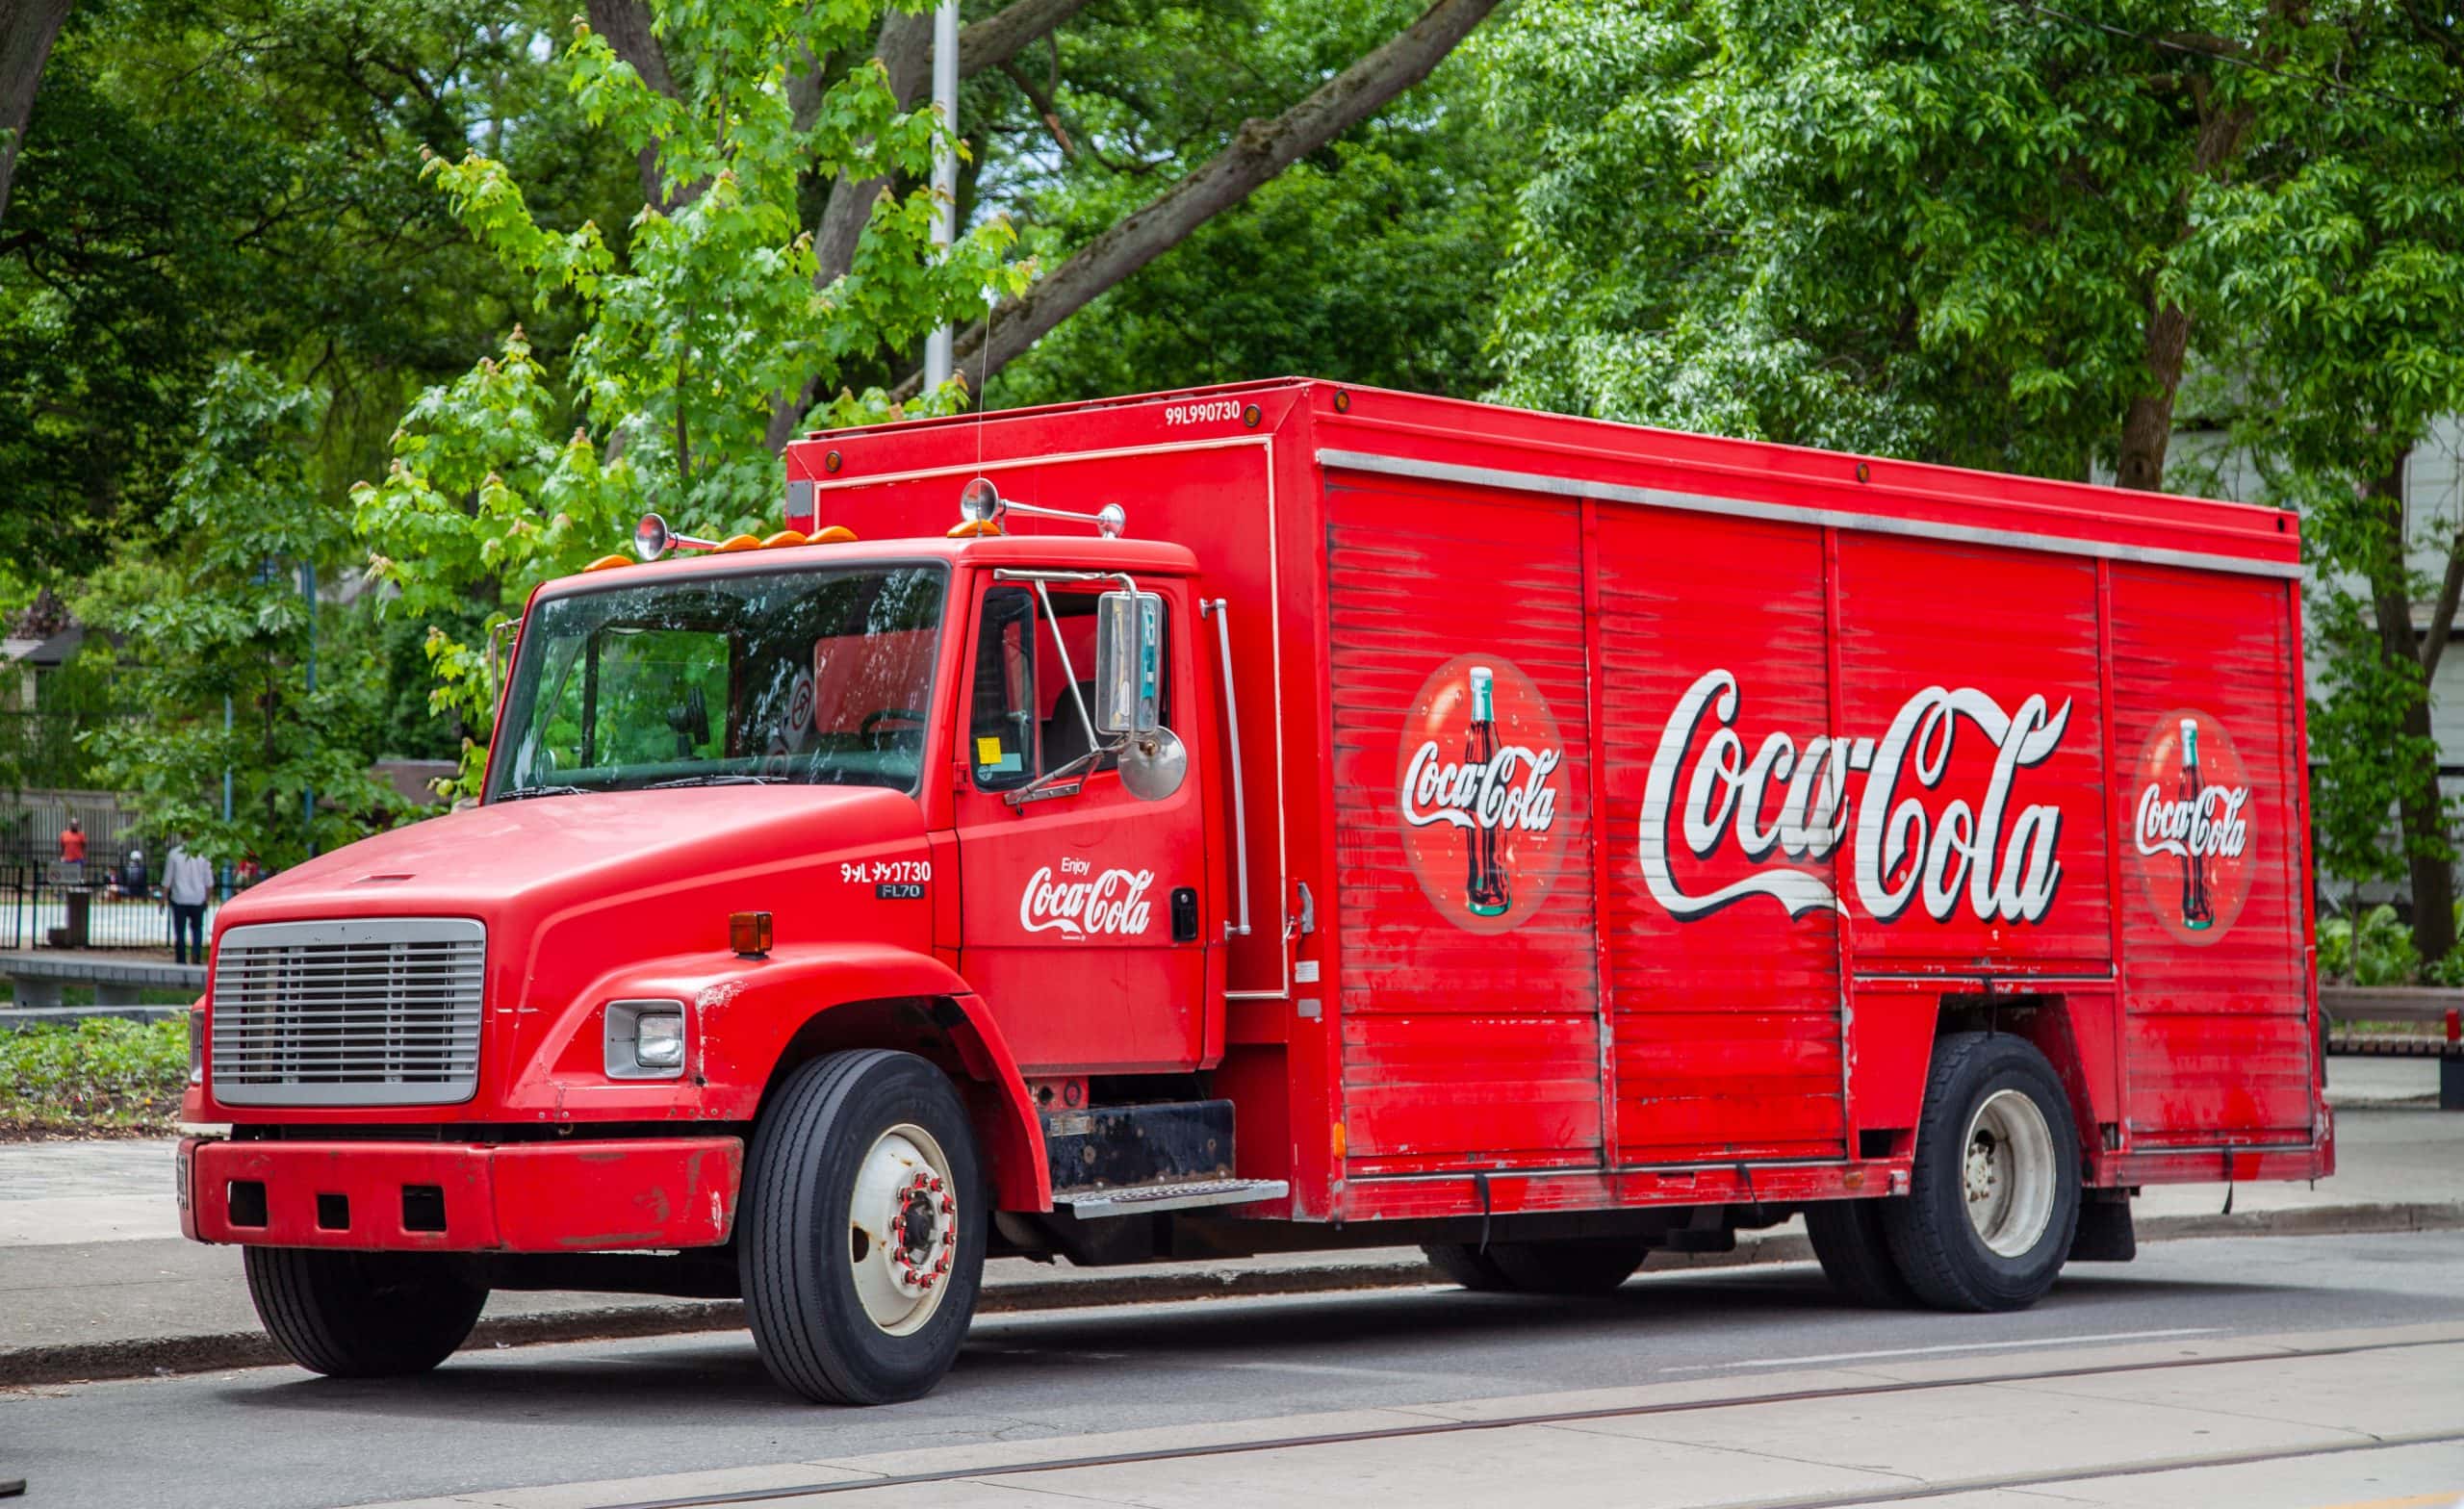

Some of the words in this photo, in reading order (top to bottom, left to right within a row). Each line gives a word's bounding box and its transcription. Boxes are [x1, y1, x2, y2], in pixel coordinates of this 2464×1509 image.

[1165, 400, 1241, 425] 99L990730
[1401, 740, 1561, 831] Coca-Cola
[1638, 668, 2072, 924] Coca-Cola
[2135, 782, 2249, 857] Coca-Cola
[882, 884, 921, 898] FL70
[1019, 866, 1155, 934] Coca-Cola
[1061, 857, 1091, 876] Enjoy
